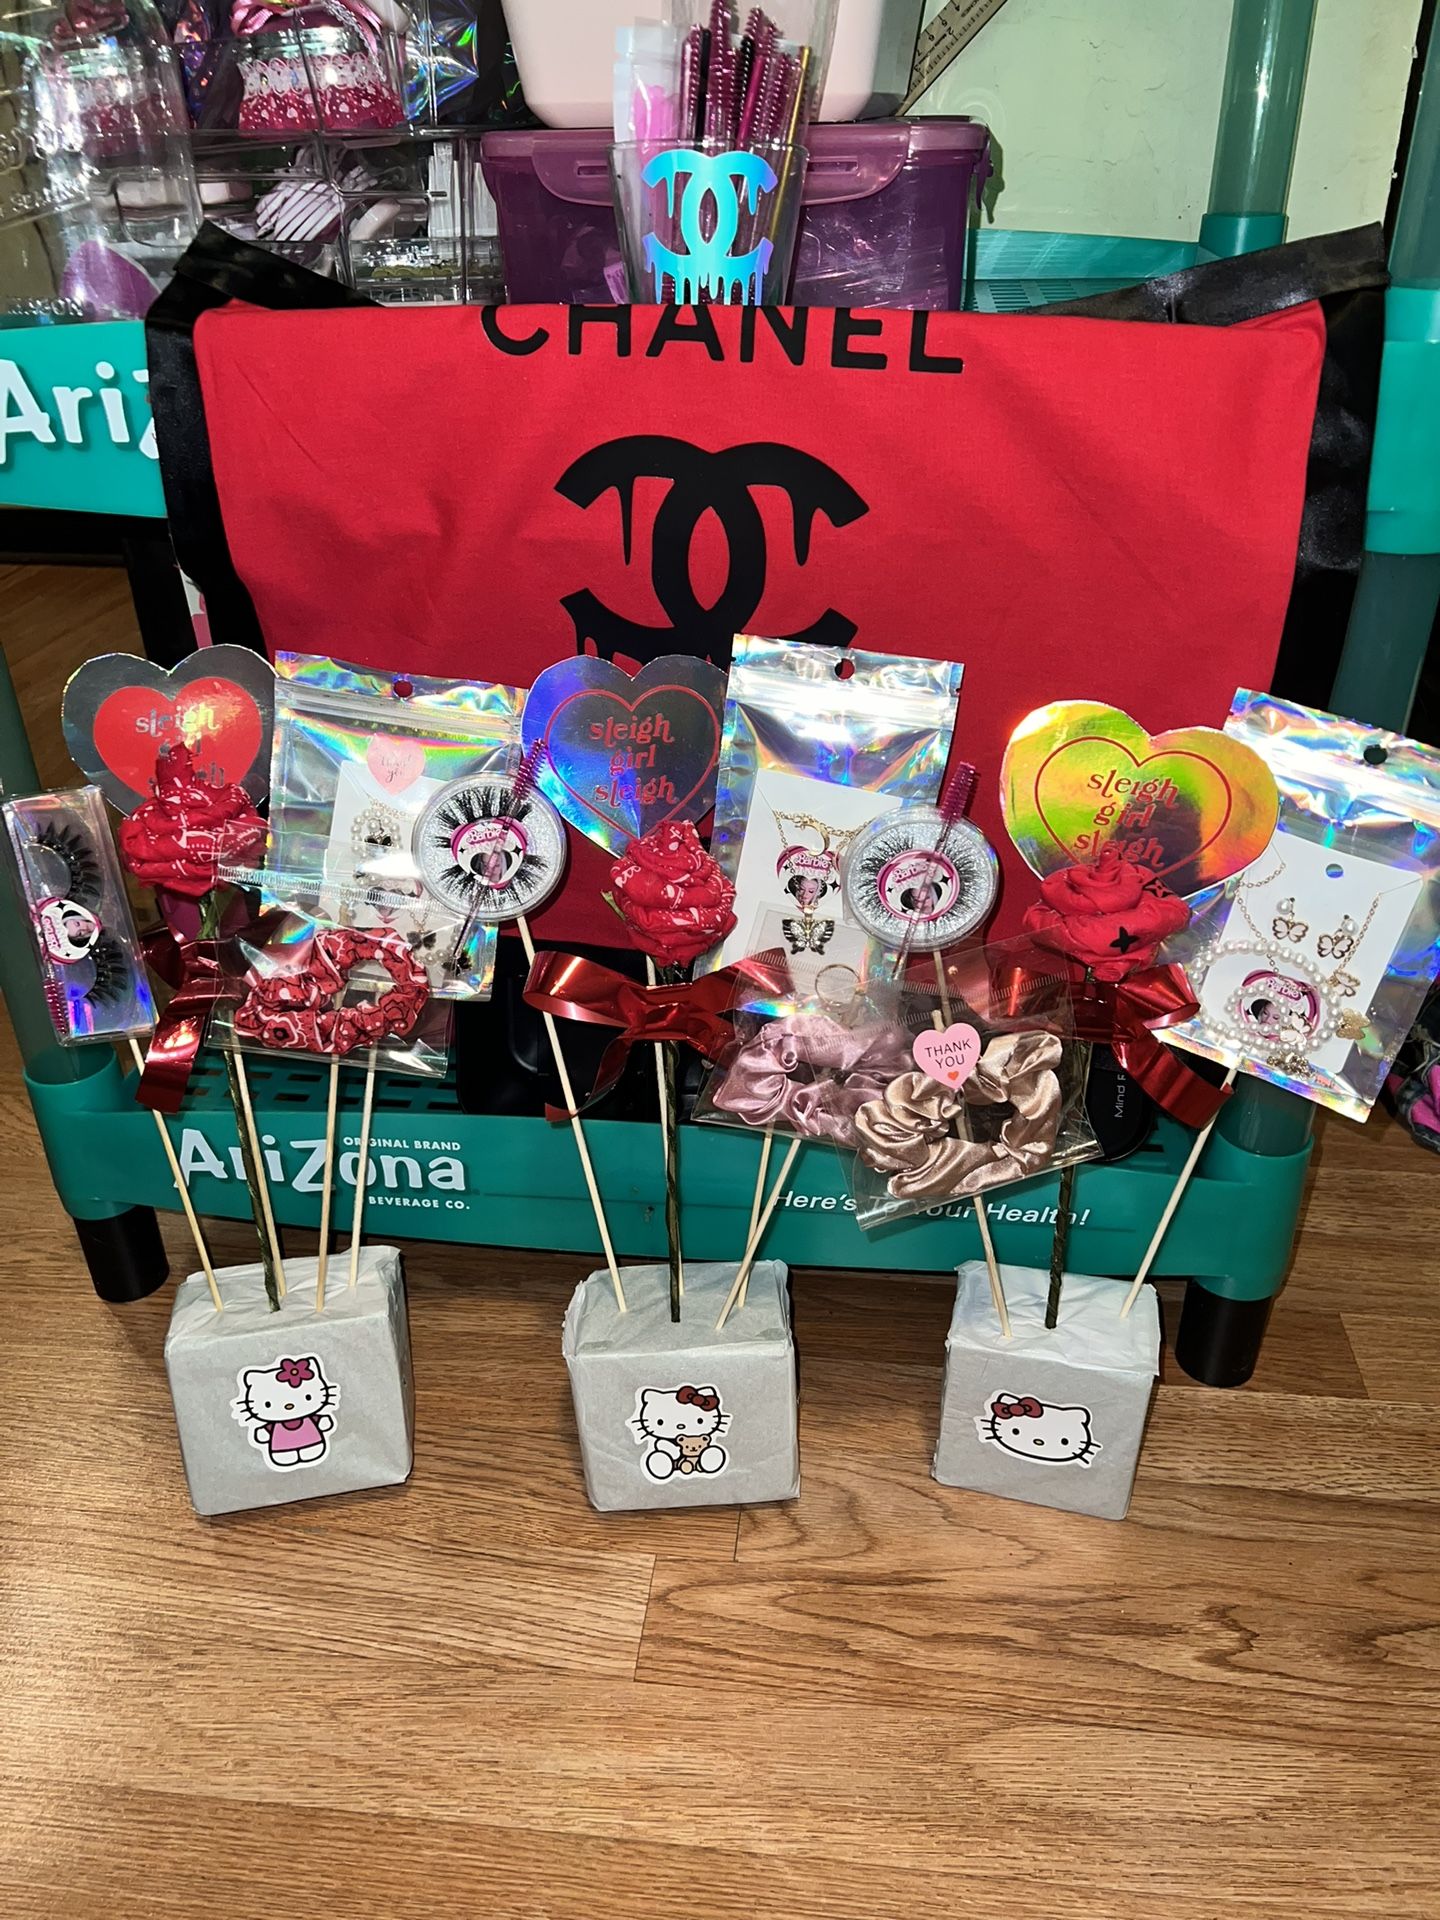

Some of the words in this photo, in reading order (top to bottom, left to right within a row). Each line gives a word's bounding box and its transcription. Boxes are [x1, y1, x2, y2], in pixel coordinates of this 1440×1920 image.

[480, 303, 964, 374] CHANEL
[589, 712, 676, 748] sleigh
[609, 743, 657, 777] girl
[593, 774, 680, 809] sleigh
[1087, 769, 1180, 809] sleigh
[1093, 801, 1157, 828] girl
[795, 852, 831, 872] Barbie
[1073, 829, 1165, 868] sleigh
[892, 862, 929, 884] Barbie
[924, 1039, 972, 1058] THANK
[935, 1053, 966, 1069] YOU
[1113, 1085, 1126, 1118] Mind
[342, 1136, 411, 1149] ORGINAL
[413, 1140, 462, 1151] BRAND
[173, 1128, 467, 1193] AriZona
[367, 1195, 440, 1208] BEVERAGE
[445, 1200, 471, 1211] CO.
[773, 1190, 858, 1212] Here's
